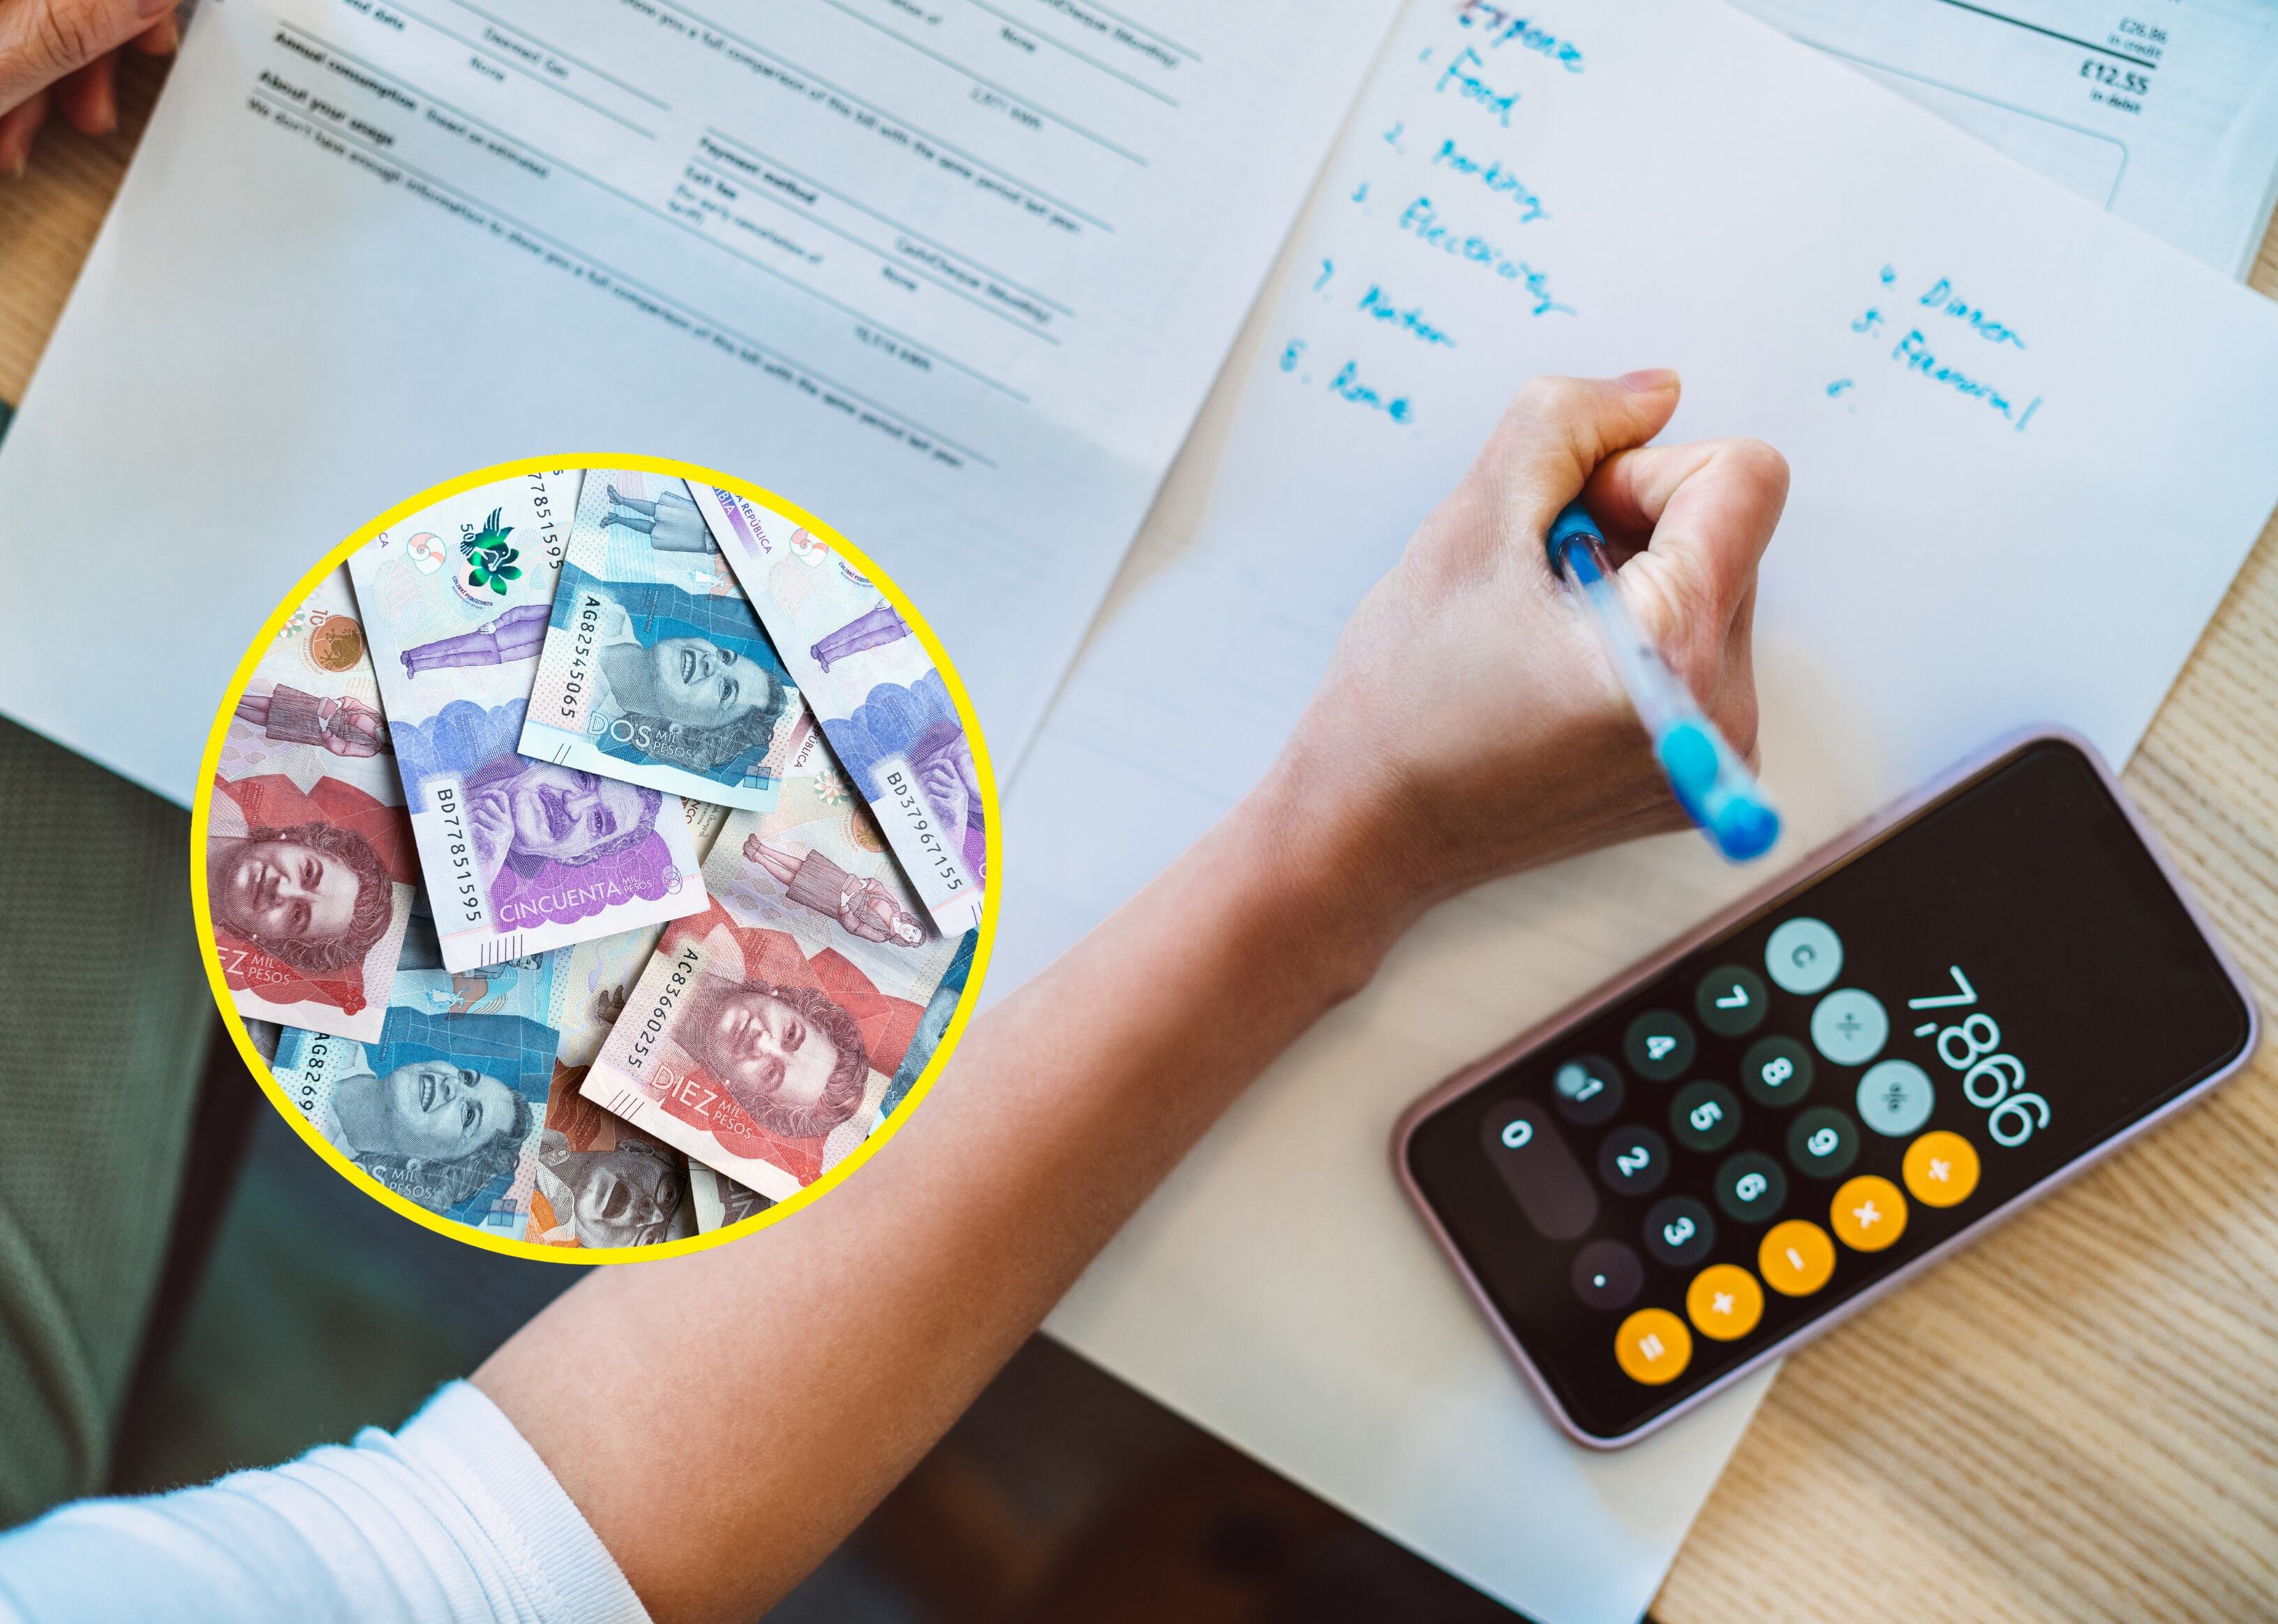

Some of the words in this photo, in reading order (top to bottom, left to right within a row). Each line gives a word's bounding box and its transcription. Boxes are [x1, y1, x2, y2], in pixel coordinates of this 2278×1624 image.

[2124, 40, 2163, 61] credit
[274, 31, 325, 64] Annual
[326, 58, 418, 114] consumption
[2078, 57, 2150, 96] £12.55
[260, 69, 308, 103] About
[307, 98, 345, 126] your
[2106, 92, 2141, 117] debit
[247, 98, 271, 116] We
[315, 131, 347, 155] have
[348, 149, 401, 186] enough
[697, 135, 761, 179] Payment
[761, 168, 819, 206] method
[461, 523, 475, 542] 50
[741, 502, 772, 554] REPÚBLICA
[310, 609, 328, 627] 10
[465, 593, 493, 606] PIQUICORTO
[560, 595, 601, 720] AG82545065
[587, 710, 652, 748] DOS
[655, 731, 678, 744] MIL
[653, 741, 693, 759] PESOS
[794, 725, 822, 768] EPÚBLICA
[886, 771, 965, 892] BD37967155
[437, 789, 482, 921] BD77851595
[500, 879, 623, 923] CINCUENTA
[623, 874, 637, 884] MIL
[623, 880, 653, 894] PESOS
[248, 967, 290, 985] PESOS
[251, 954, 275, 969] MIL
[1792, 944, 1815, 969] C
[627, 948, 699, 1070] AC83660255
[299, 1032, 330, 1121] AG8269
[1715, 985, 1750, 1009] 7
[1762, 1057, 1794, 1086] 8
[1808, 1128, 1840, 1157] 9
[1907, 965, 2050, 1147] 7,866
[650, 1064, 719, 1117] DIEZ
[718, 1100, 743, 1119] MIL
[713, 1110, 753, 1139] PESOS
[1502, 1119, 1533, 1148] 0
[1646, 1035, 1676, 1061] 4
[1690, 1101, 1723, 1131] 5
[1736, 1172, 1768, 1202] 6
[391, 1168, 415, 1183] MIL
[1574, 1078, 1604, 1103] 1
[1616, 1147, 1650, 1177] 2
[1663, 1217, 1696, 1246] 3
[389, 1182, 433, 1200] PESOS
